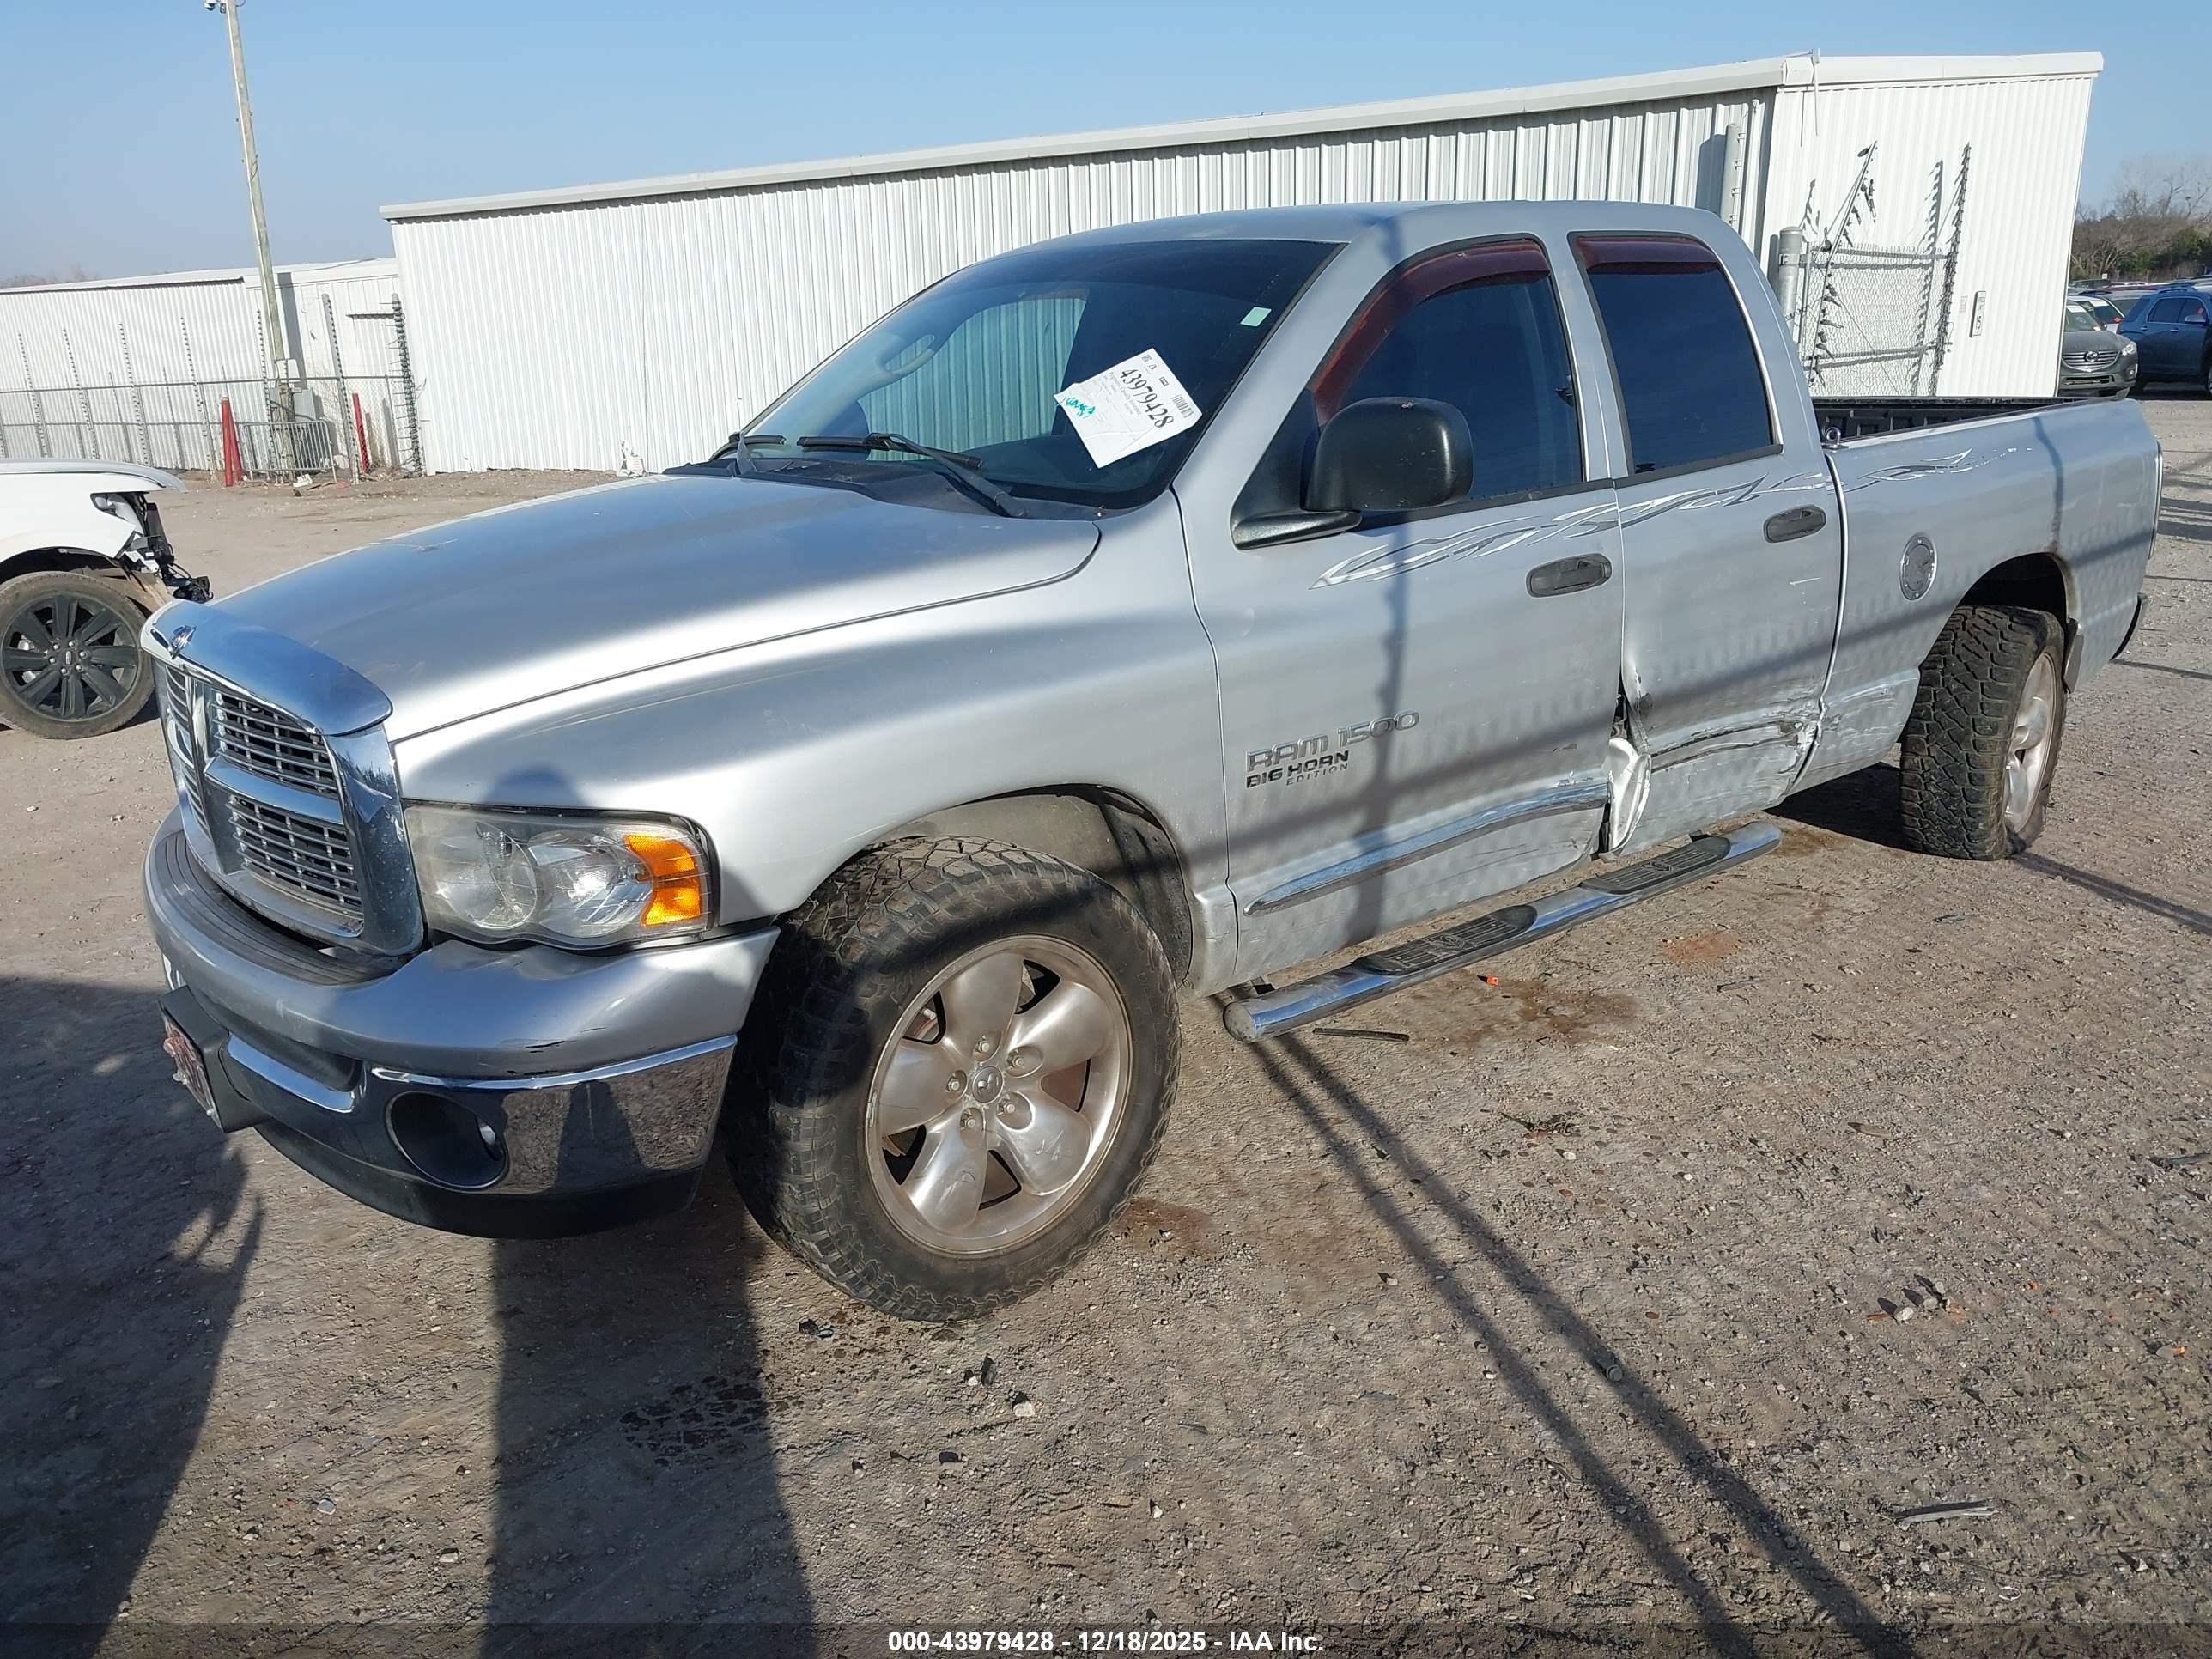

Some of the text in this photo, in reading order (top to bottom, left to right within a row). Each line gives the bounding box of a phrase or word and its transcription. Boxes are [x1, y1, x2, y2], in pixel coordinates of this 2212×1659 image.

[1119, 368, 1175, 428] 43979428
[1246, 709, 1420, 772] RAM 1500
[1246, 750, 1350, 788] BIG HORN
[1285, 762, 1349, 787] EDITION
